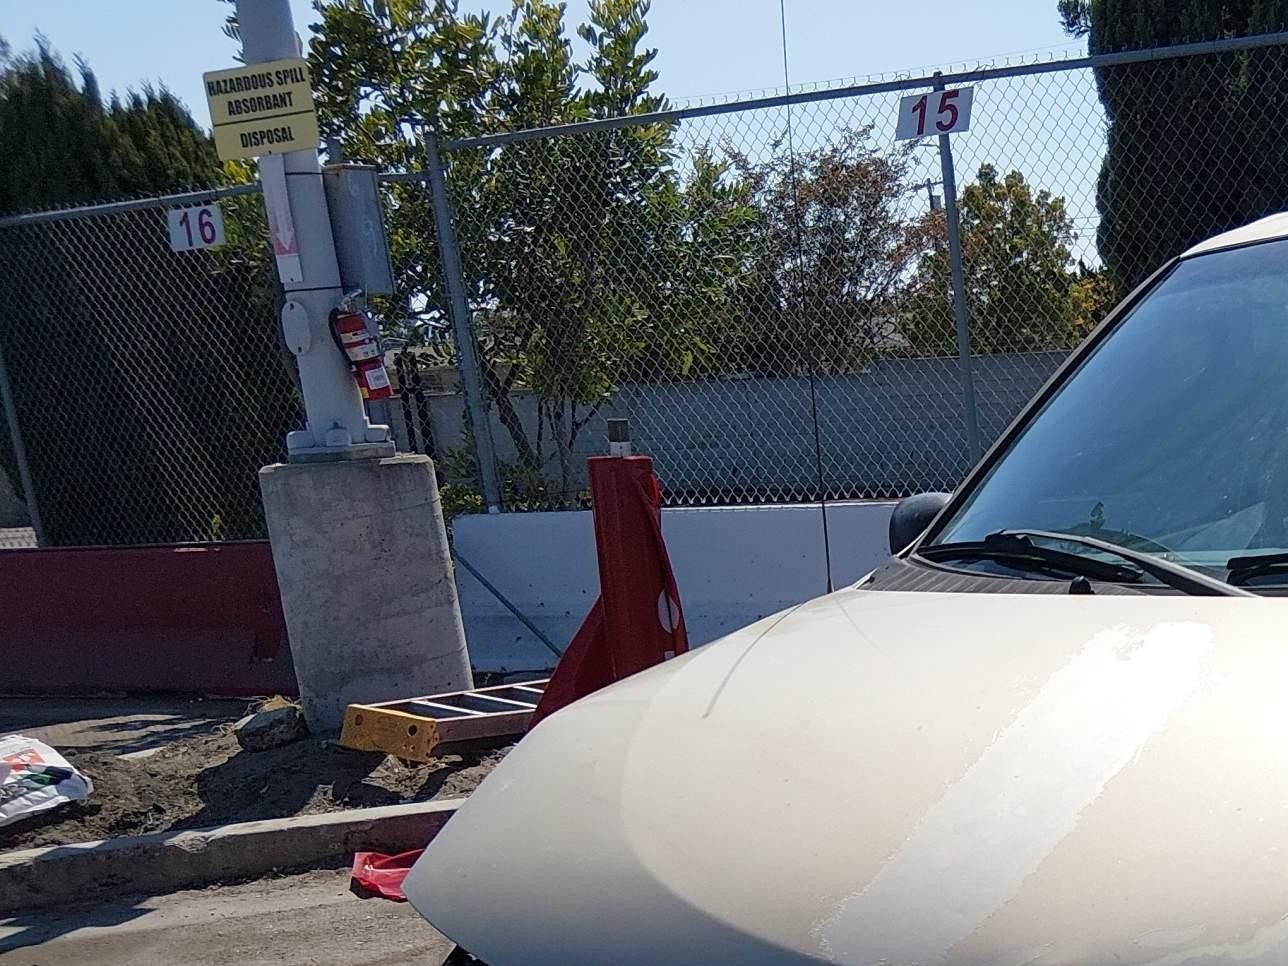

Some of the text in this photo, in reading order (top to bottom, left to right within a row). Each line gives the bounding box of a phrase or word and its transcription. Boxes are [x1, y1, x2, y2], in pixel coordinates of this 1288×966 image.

[207, 67, 306, 97] HAZARDOUS SPILL
[227, 91, 294, 116] ABSORBANT
[911, 89, 960, 136] 15
[240, 126, 295, 148] DISPOSAL
[179, 208, 217, 247] 16
